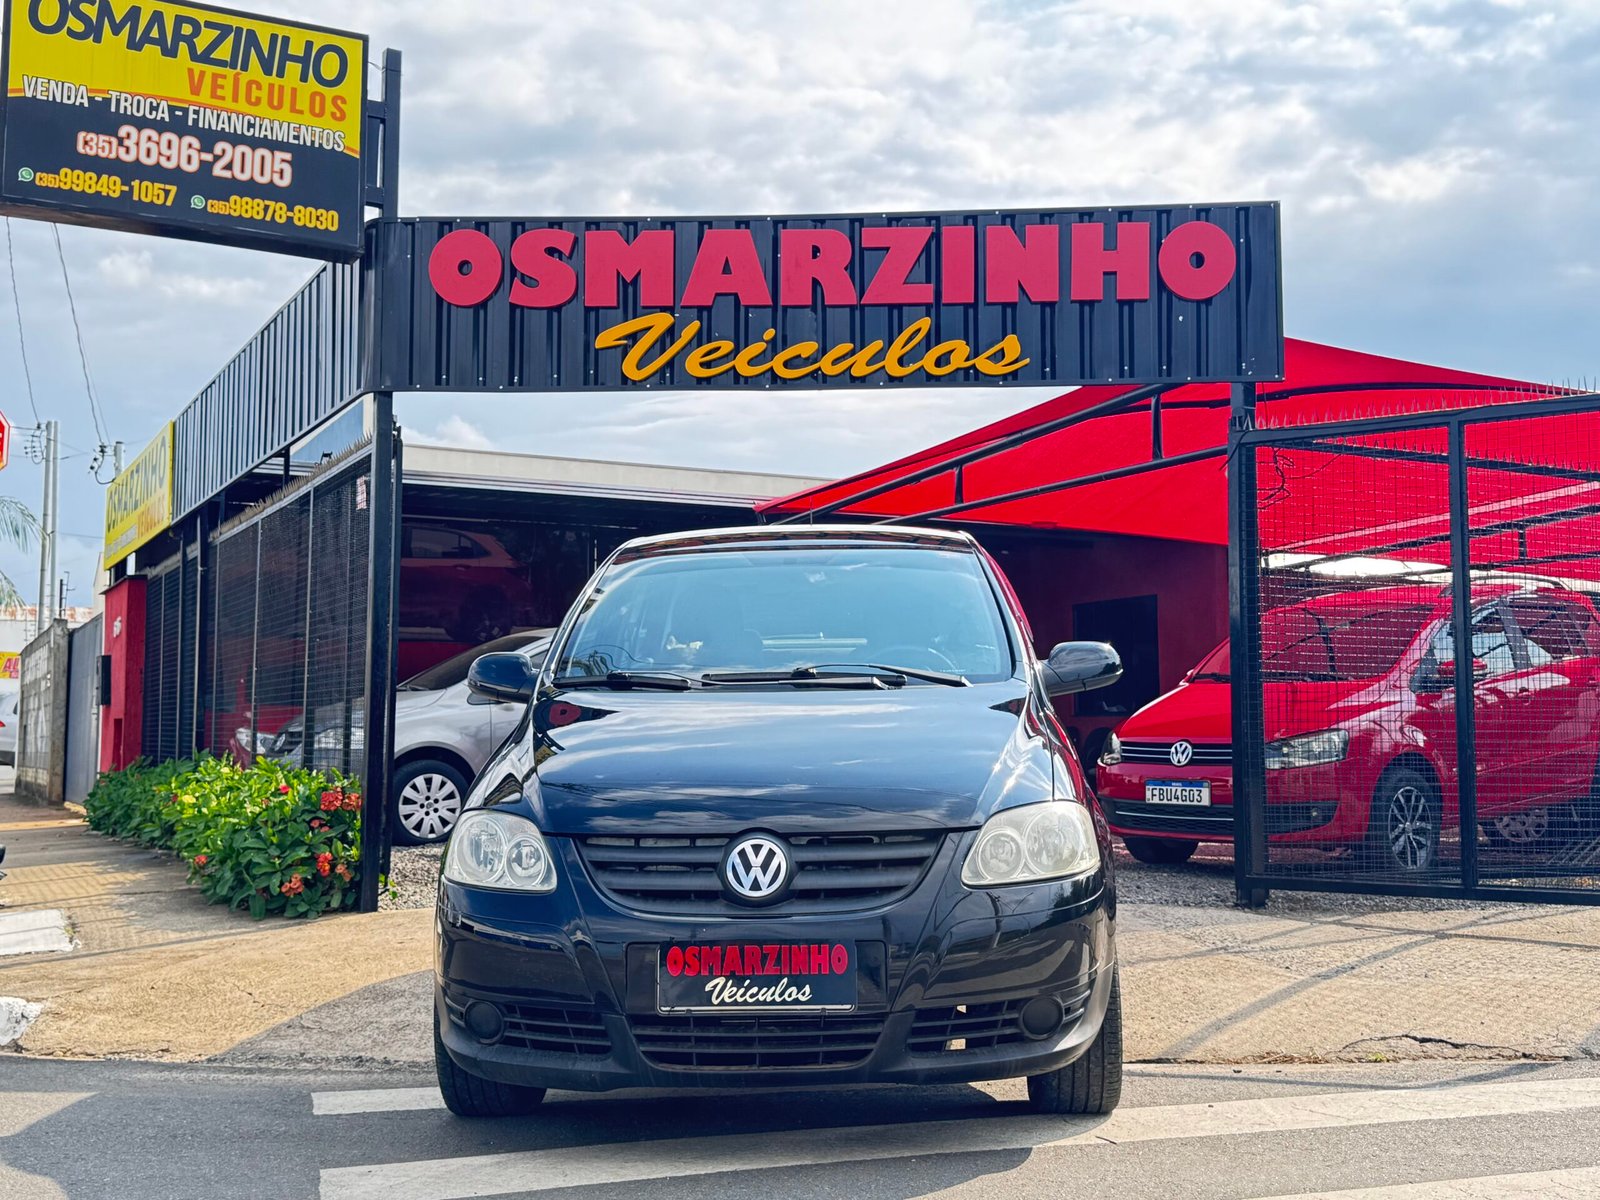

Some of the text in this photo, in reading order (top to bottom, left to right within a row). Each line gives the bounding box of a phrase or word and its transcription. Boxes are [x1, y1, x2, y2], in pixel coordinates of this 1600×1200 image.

[27, 0, 349, 89] OSMARZINHO
[22, 74, 90, 108] VENDA
[107, 90, 170, 123] TROCA
[187, 104, 347, 152] FINANCIAMENTOS
[187, 67, 348, 122] VEÍCULOS
[428, 220, 1237, 308] OSMARZINHO
[1150, 787, 1203, 803] FBU4G03
[666, 943, 849, 977] OSMARZINHO
